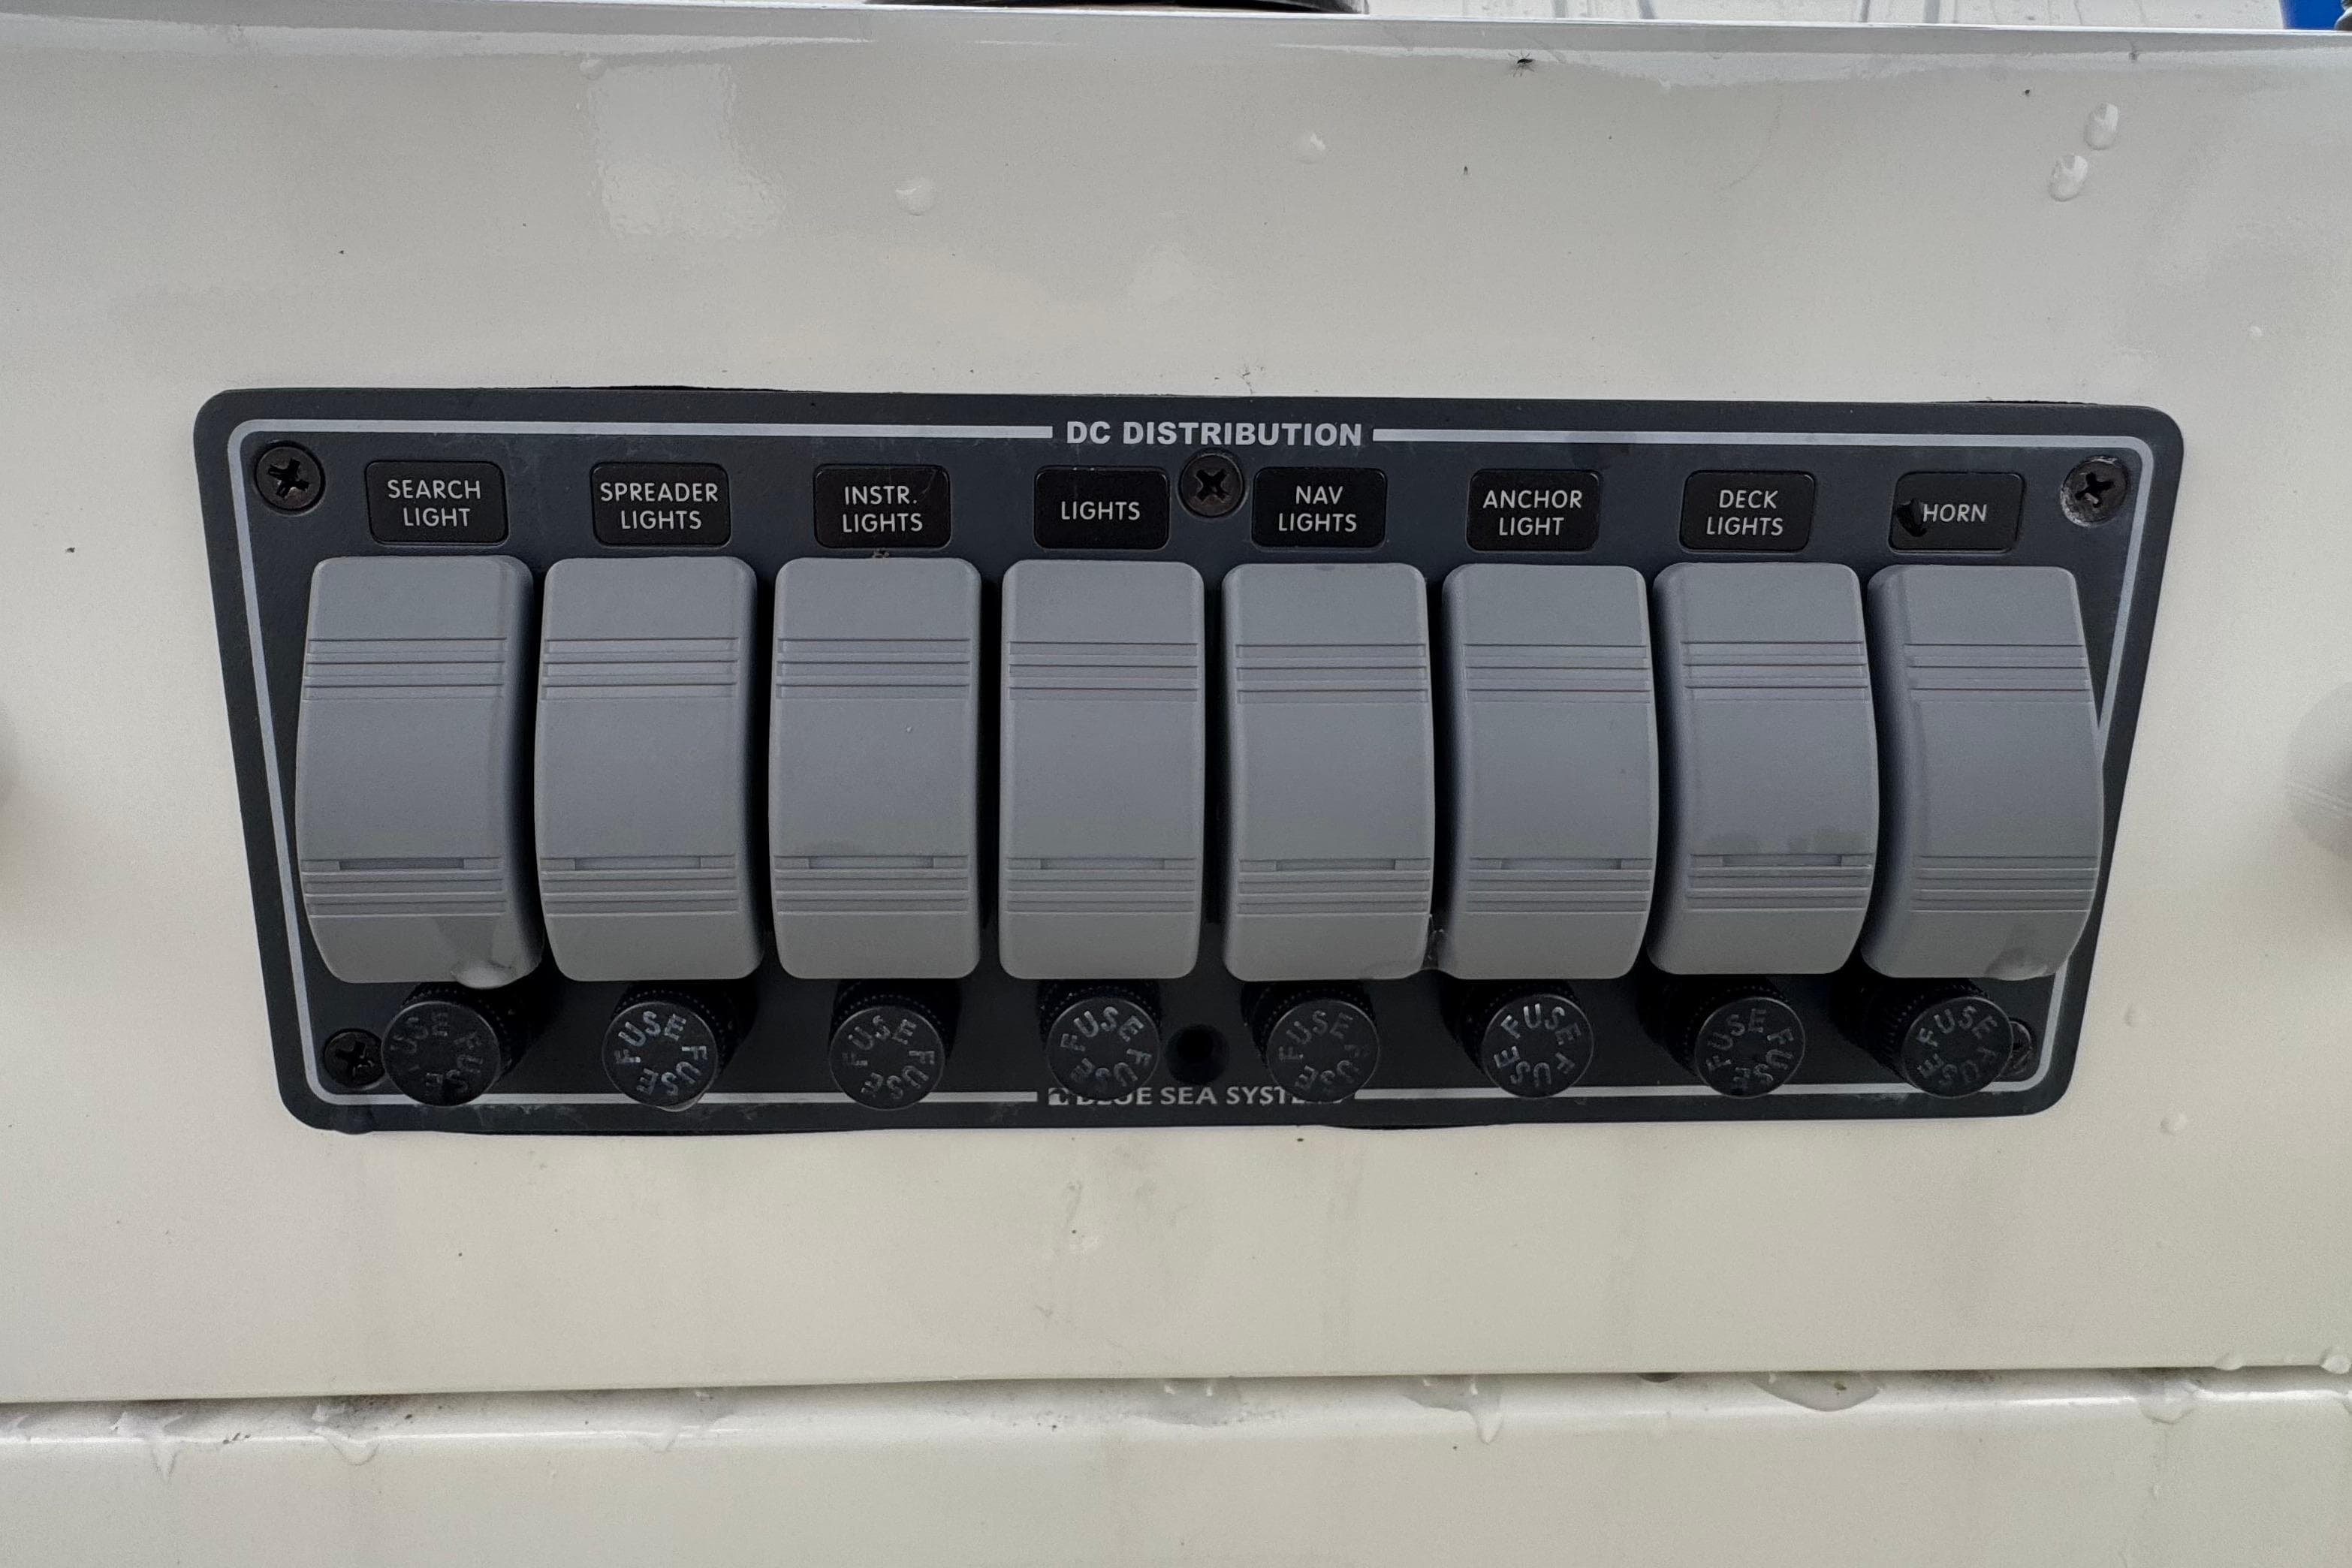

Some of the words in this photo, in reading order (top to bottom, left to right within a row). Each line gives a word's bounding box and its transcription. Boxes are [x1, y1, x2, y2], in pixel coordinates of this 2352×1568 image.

[1066, 421, 1111, 445] DC
[1123, 421, 1361, 446] DISTRIBUTION
[387, 479, 481, 499] SEARCH
[600, 482, 718, 502] SPREADER
[844, 485, 918, 506] INSTR.
[1295, 485, 1343, 505] NAV
[1482, 490, 1582, 509] ANCHOR
[1719, 490, 1778, 509] DECK
[403, 508, 471, 526] LIGHT
[621, 510, 701, 529] LIGHTS
[1061, 501, 1140, 520] LIGHTS
[1922, 503, 1987, 522] HORN
[843, 513, 923, 533] LIGHTS
[1278, 513, 1357, 532] LIGHTS
[1499, 517, 1564, 536] LIGHT
[1706, 516, 1783, 536] LIGHTS
[1060, 1006, 1144, 1051] FUSE
[1500, 1003, 1581, 1045] FUSE
[1917, 1006, 1998, 1047] FUSE
[614, 1011, 686, 1063] FUSE
[842, 1015, 916, 1066] FUSE
[1279, 1010, 1353, 1060] FUSE
[1706, 1009, 1766, 1069] FUSE
[636, 1045, 707, 1095] FUSE
[861, 1050, 935, 1099] FUSE
[1070, 1048, 1152, 1089] FUSE
[1494, 1046, 1575, 1087] FUSE
[1160, 1087, 1217, 1105] SEA
